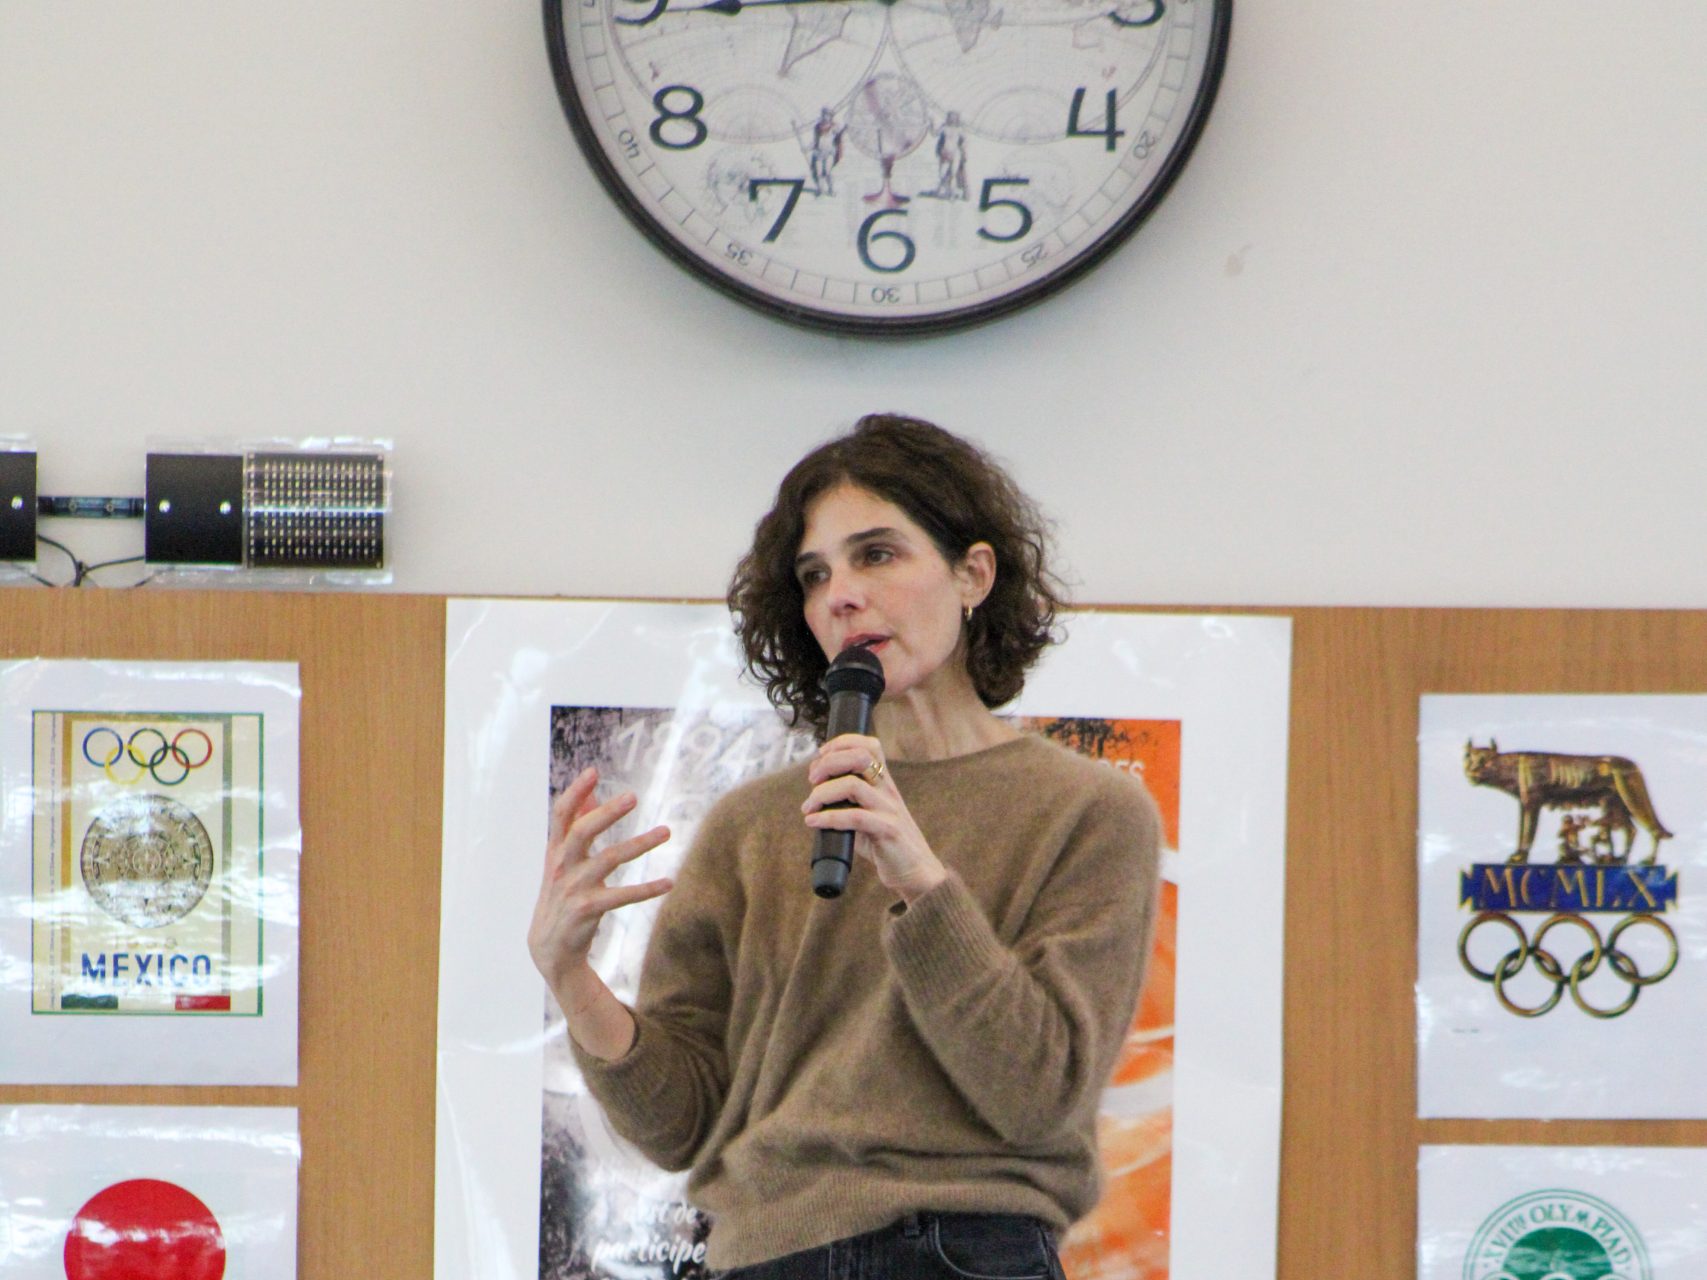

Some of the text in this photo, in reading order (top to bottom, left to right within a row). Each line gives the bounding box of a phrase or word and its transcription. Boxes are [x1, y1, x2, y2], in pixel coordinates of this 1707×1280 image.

[649, 84, 708, 150] 8
[1066, 87, 1126, 152] 4
[749, 178, 806, 244] 7
[857, 208, 916, 274] 6
[976, 178, 1033, 243] 5
[871, 286, 899, 304] 30
[81, 953, 211, 987] MEXICO
